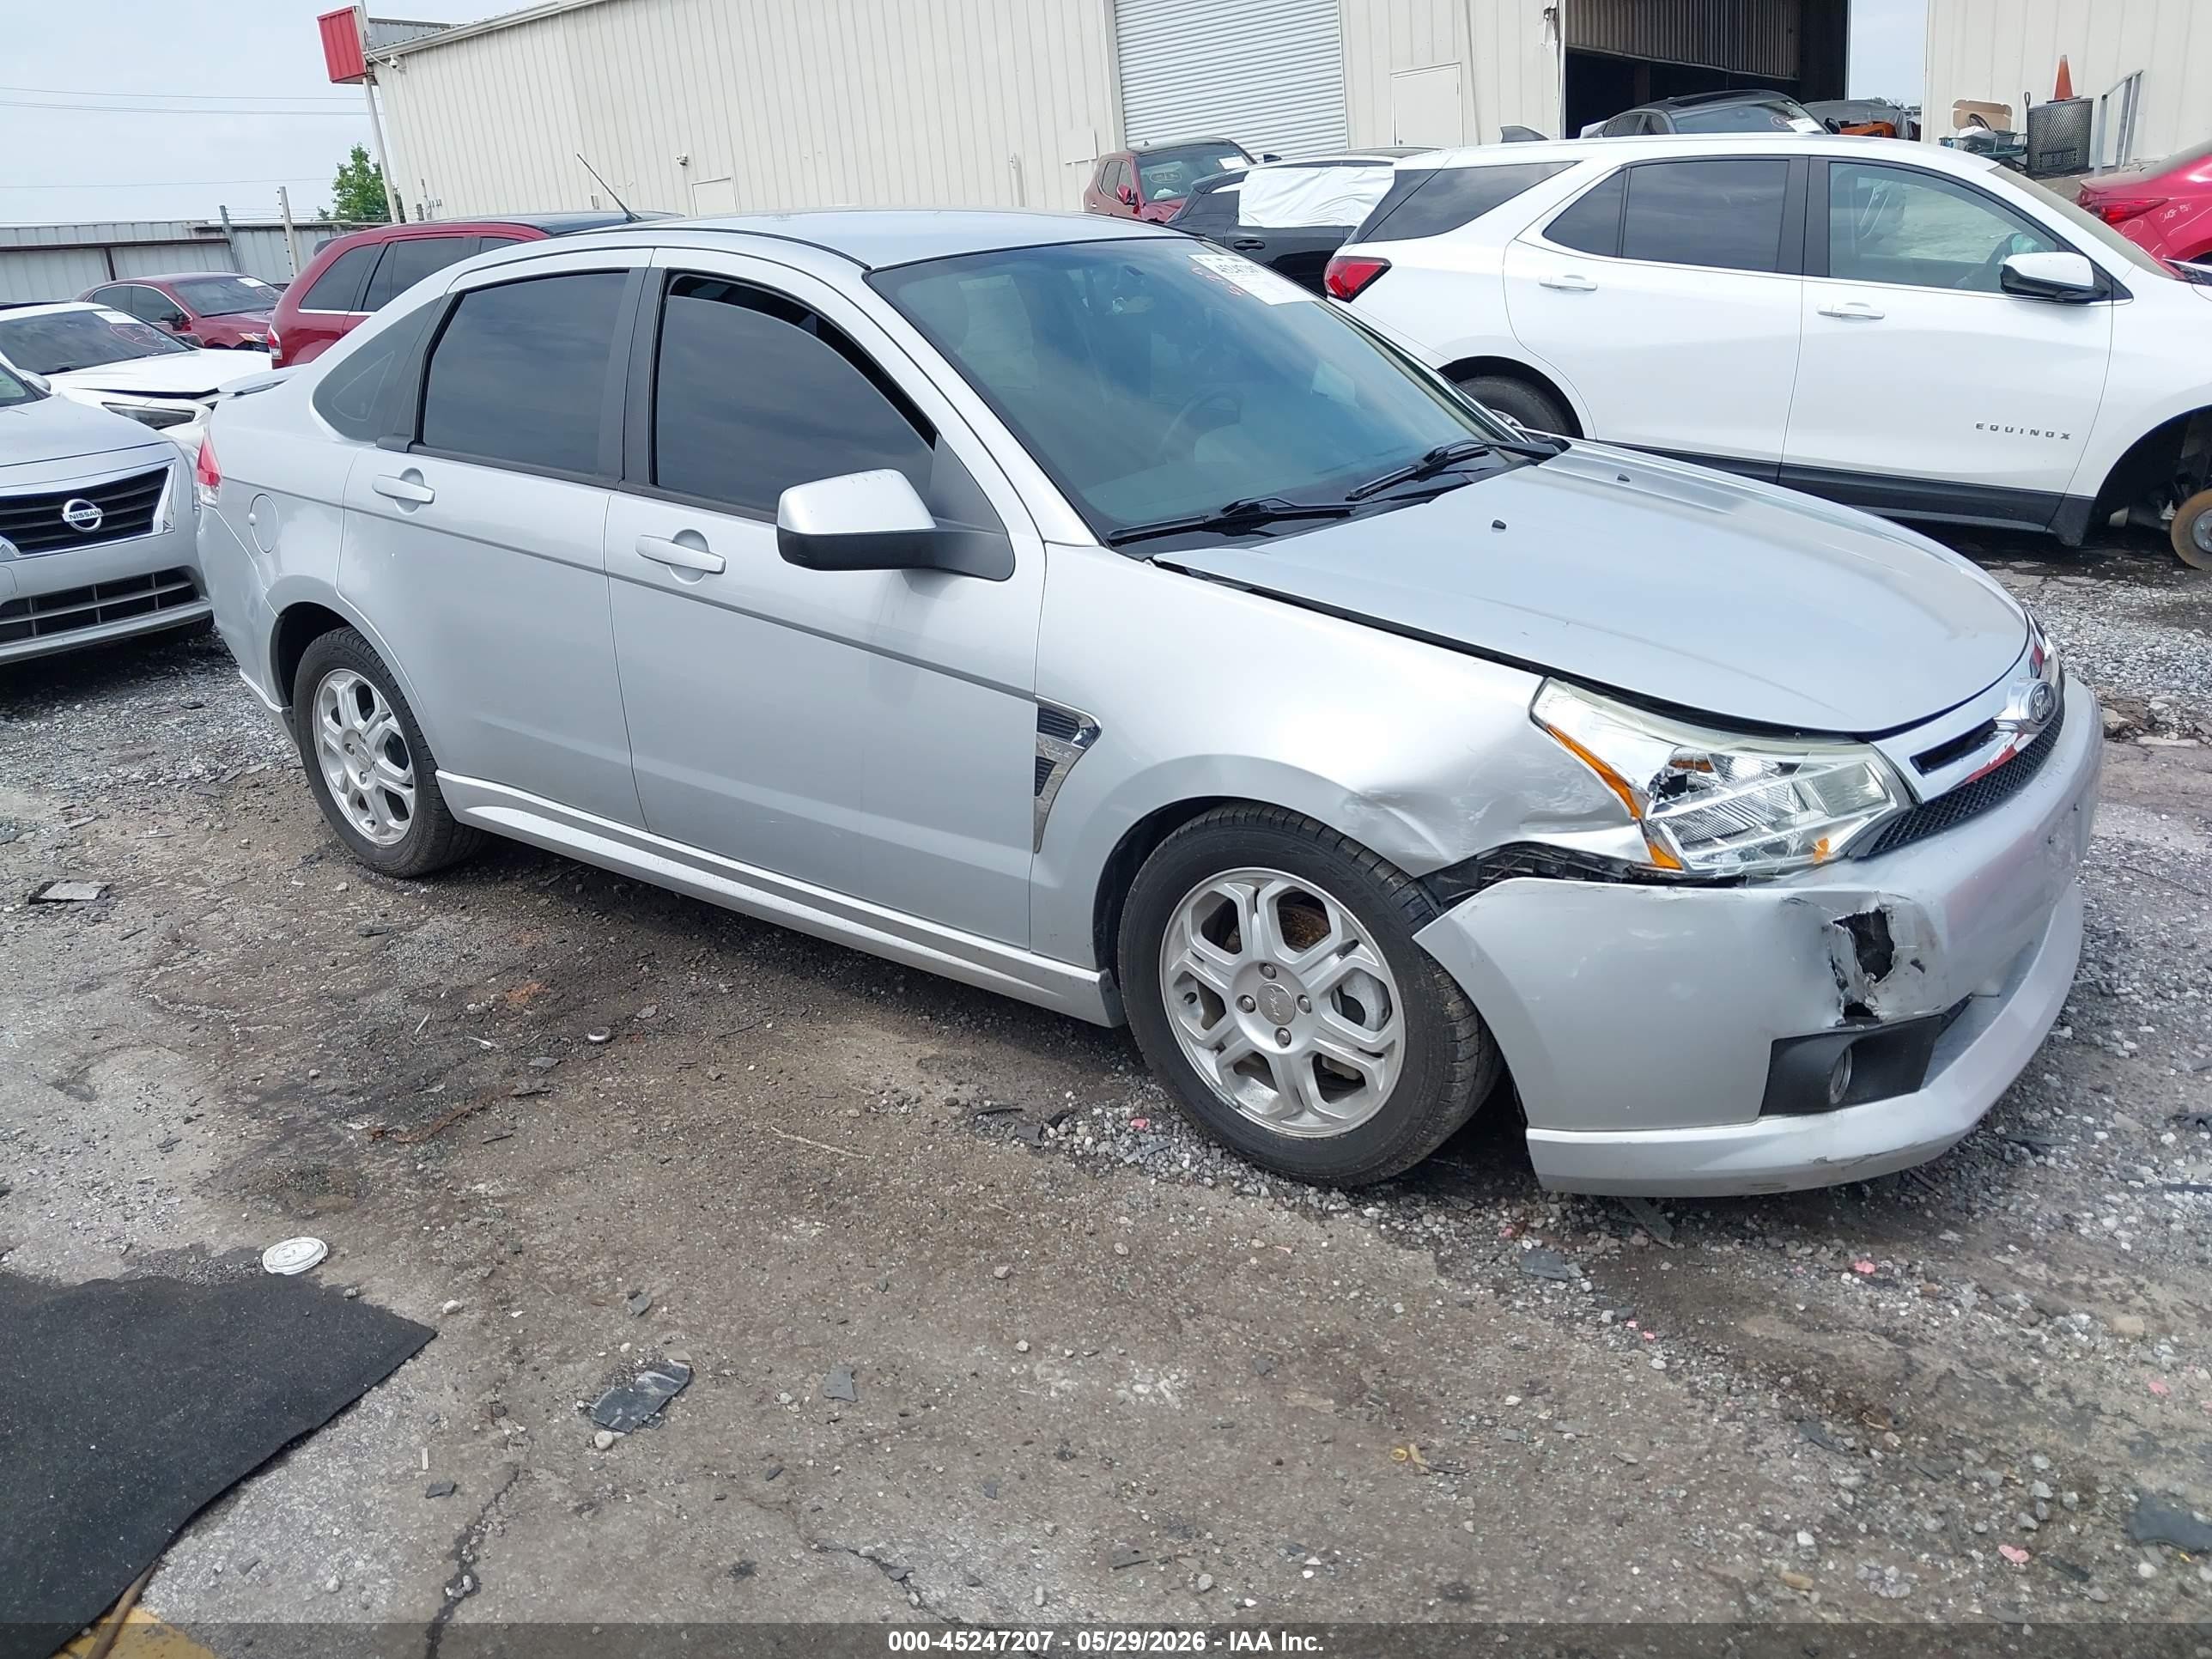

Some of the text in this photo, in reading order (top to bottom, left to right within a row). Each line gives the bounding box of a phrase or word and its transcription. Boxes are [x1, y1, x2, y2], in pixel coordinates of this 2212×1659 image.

[1975, 422, 2070, 440] EQUINOX
[69, 509, 100, 520] NISSAN
[2033, 689, 2053, 720] Ford
